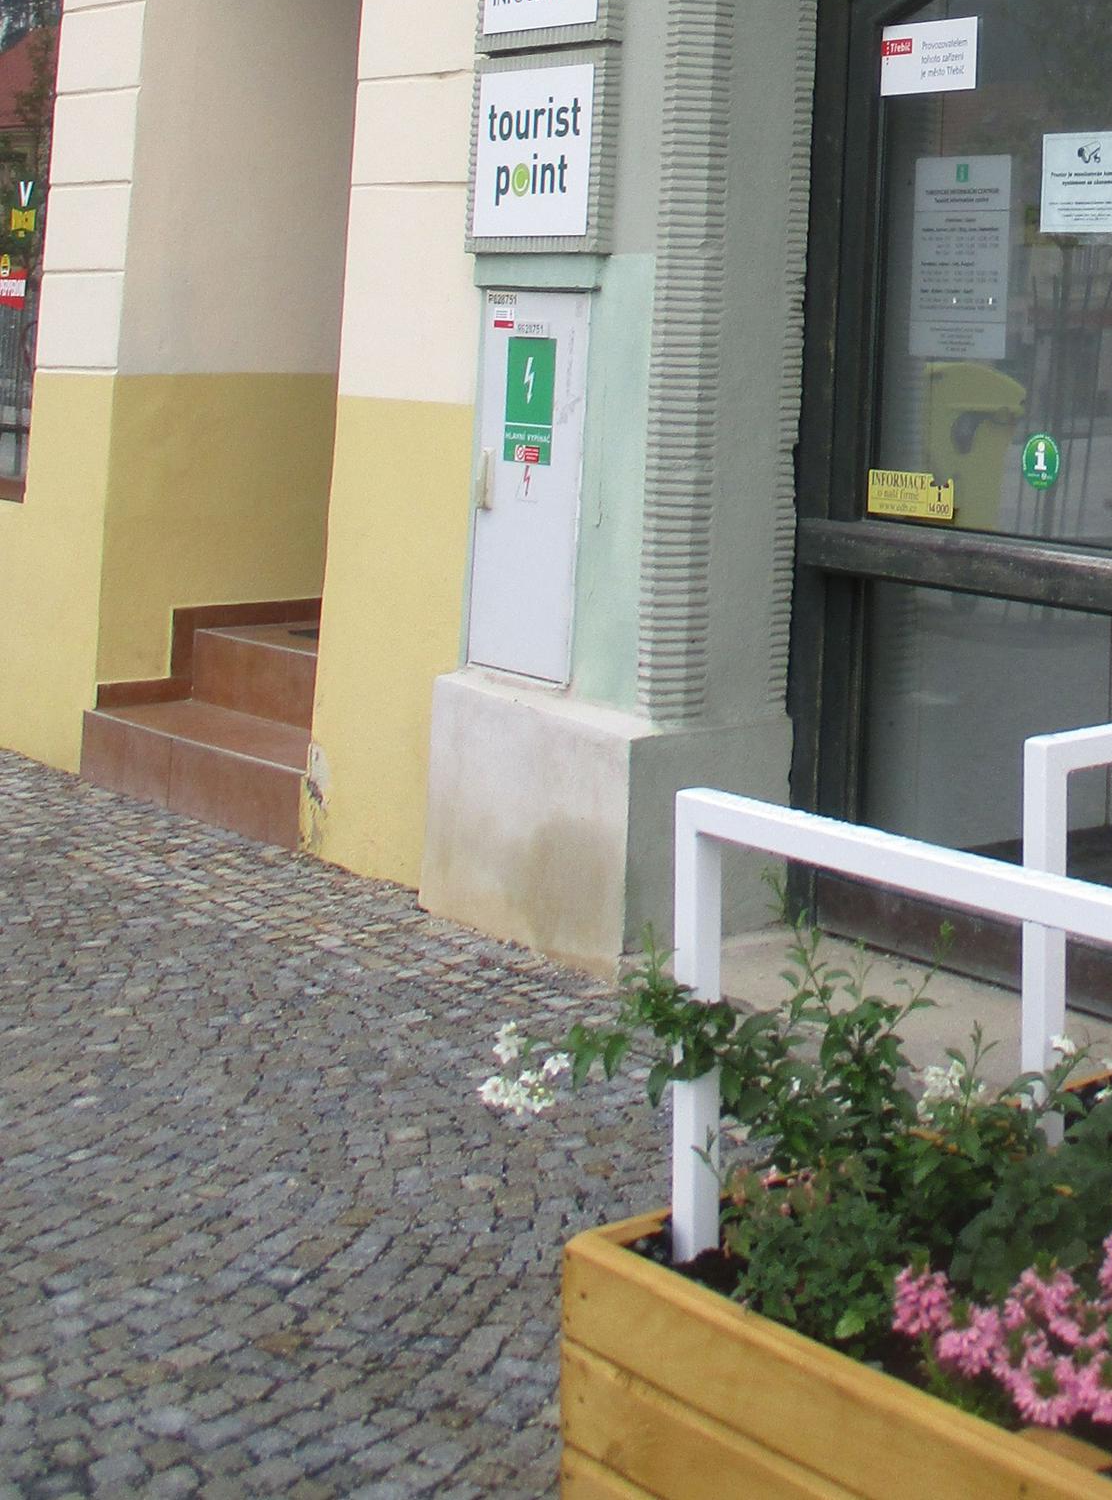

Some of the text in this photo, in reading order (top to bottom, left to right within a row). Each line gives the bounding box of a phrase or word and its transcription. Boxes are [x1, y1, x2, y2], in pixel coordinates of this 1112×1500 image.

[889, 40, 912, 53] Třebíč
[488, 96, 581, 143] tourist
[494, 153, 568, 207] point
